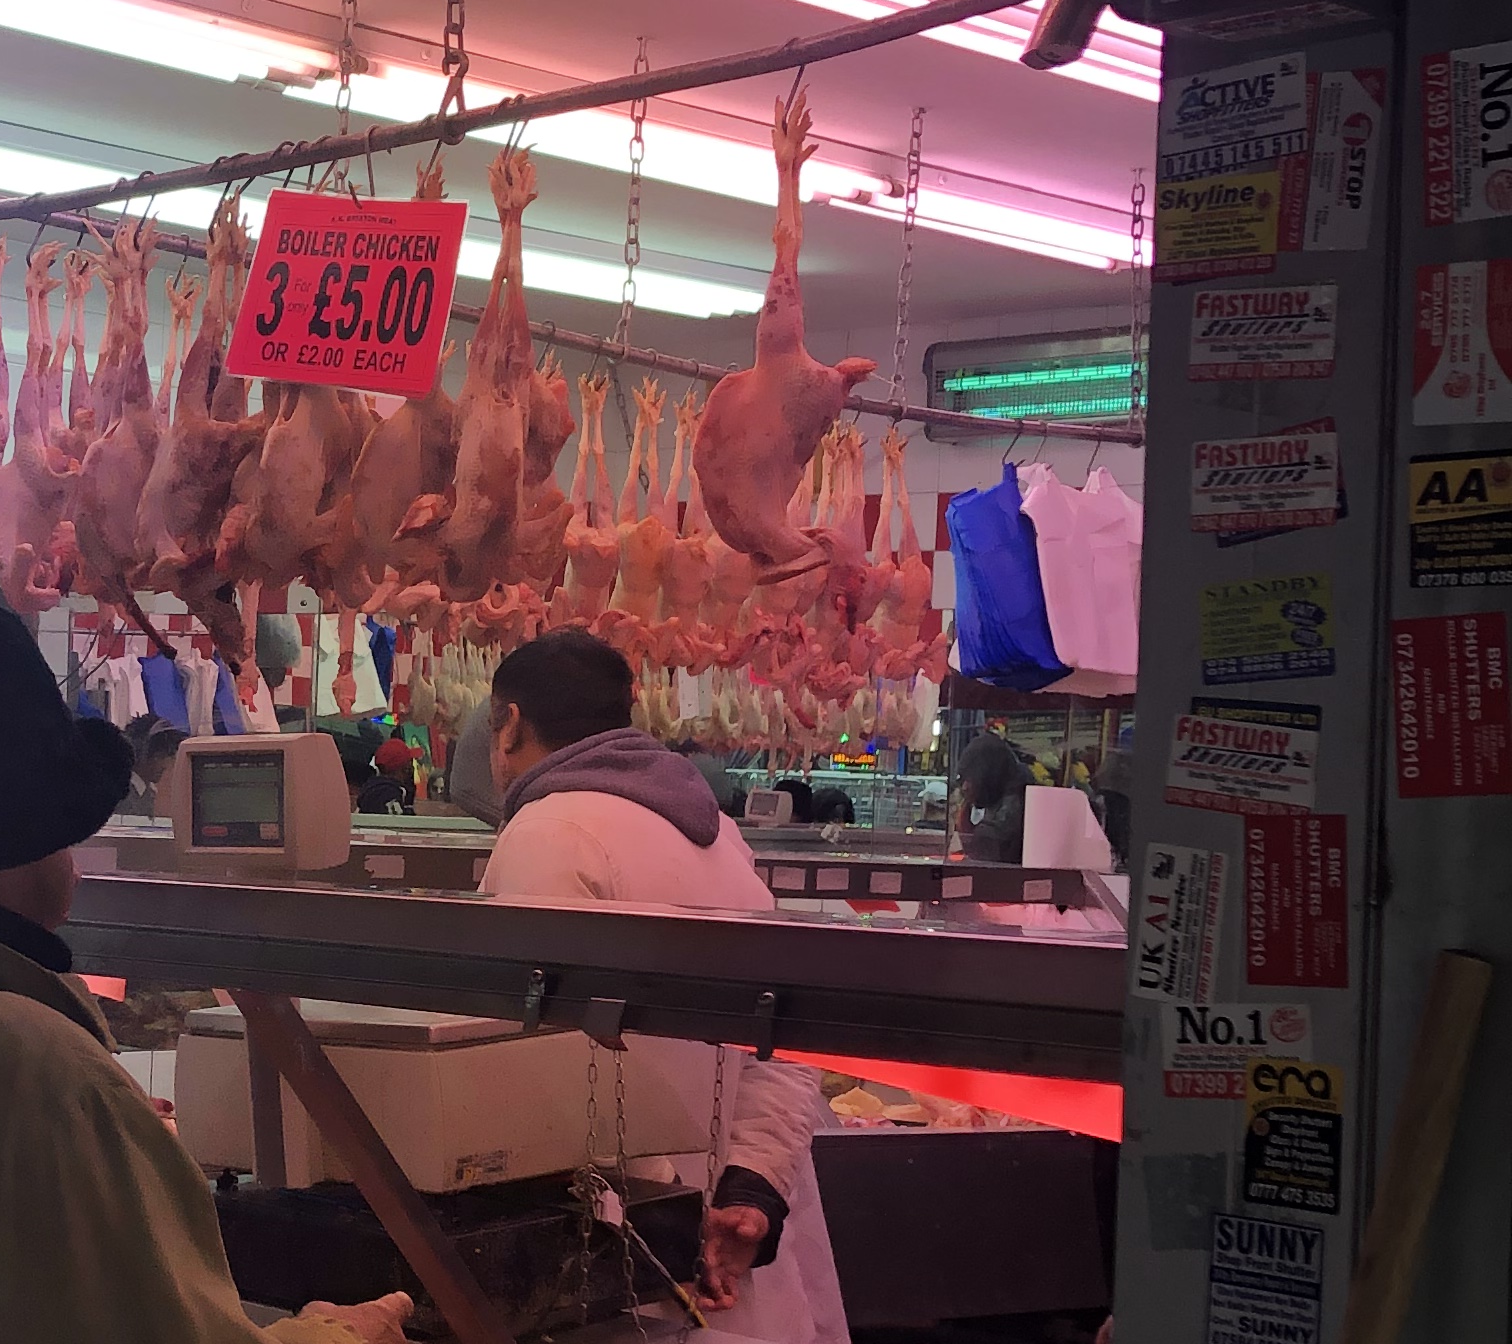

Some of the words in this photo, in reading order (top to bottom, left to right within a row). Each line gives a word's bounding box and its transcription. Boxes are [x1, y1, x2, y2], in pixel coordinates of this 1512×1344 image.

[1181, 73, 1275, 109] ACTIVE
[1426, 63, 1449, 129] 07399
[1166, 152, 1224, 176] 07445
[1230, 142, 1265, 162] 145
[1272, 134, 1305, 155] 511
[1429, 136, 1450, 172] 221
[1346, 148, 1366, 209] STOP
[1160, 184, 1256, 212] Skyline
[1430, 182, 1452, 220] 322
[277, 229, 347, 258] BOILER
[352, 233, 440, 261] CHICKEN
[256, 261, 290, 336] 3
[308, 262, 435, 346] £5.00
[1196, 292, 1310, 318] FASTWAY
[261, 341, 288, 362] OR
[297, 345, 344, 368] £2.00
[353, 350, 407, 374] EACH
[1195, 440, 1309, 468] FASTWAY
[1417, 468, 1488, 506] AA
[1464, 618, 1482, 720] SHUTTERS
[1488, 647, 1503, 690] BMC
[1396, 634, 1420, 778] 07342642010
[1177, 717, 1290, 758] FASTWAY
[1308, 819, 1322, 916] SHUTTERS
[1328, 848, 1342, 888] BMC
[1249, 828, 1267, 967] 07342642010
[1139, 943, 1165, 989] UK
[1176, 1006, 1267, 1044] No.1
[1170, 1072, 1228, 1094] 07399
[1254, 1064, 1331, 1100] era
[1250, 1182, 1278, 1200] 0777
[1217, 1218, 1318, 1265] SUNNY
[1238, 1316, 1314, 1344] SUNNY
